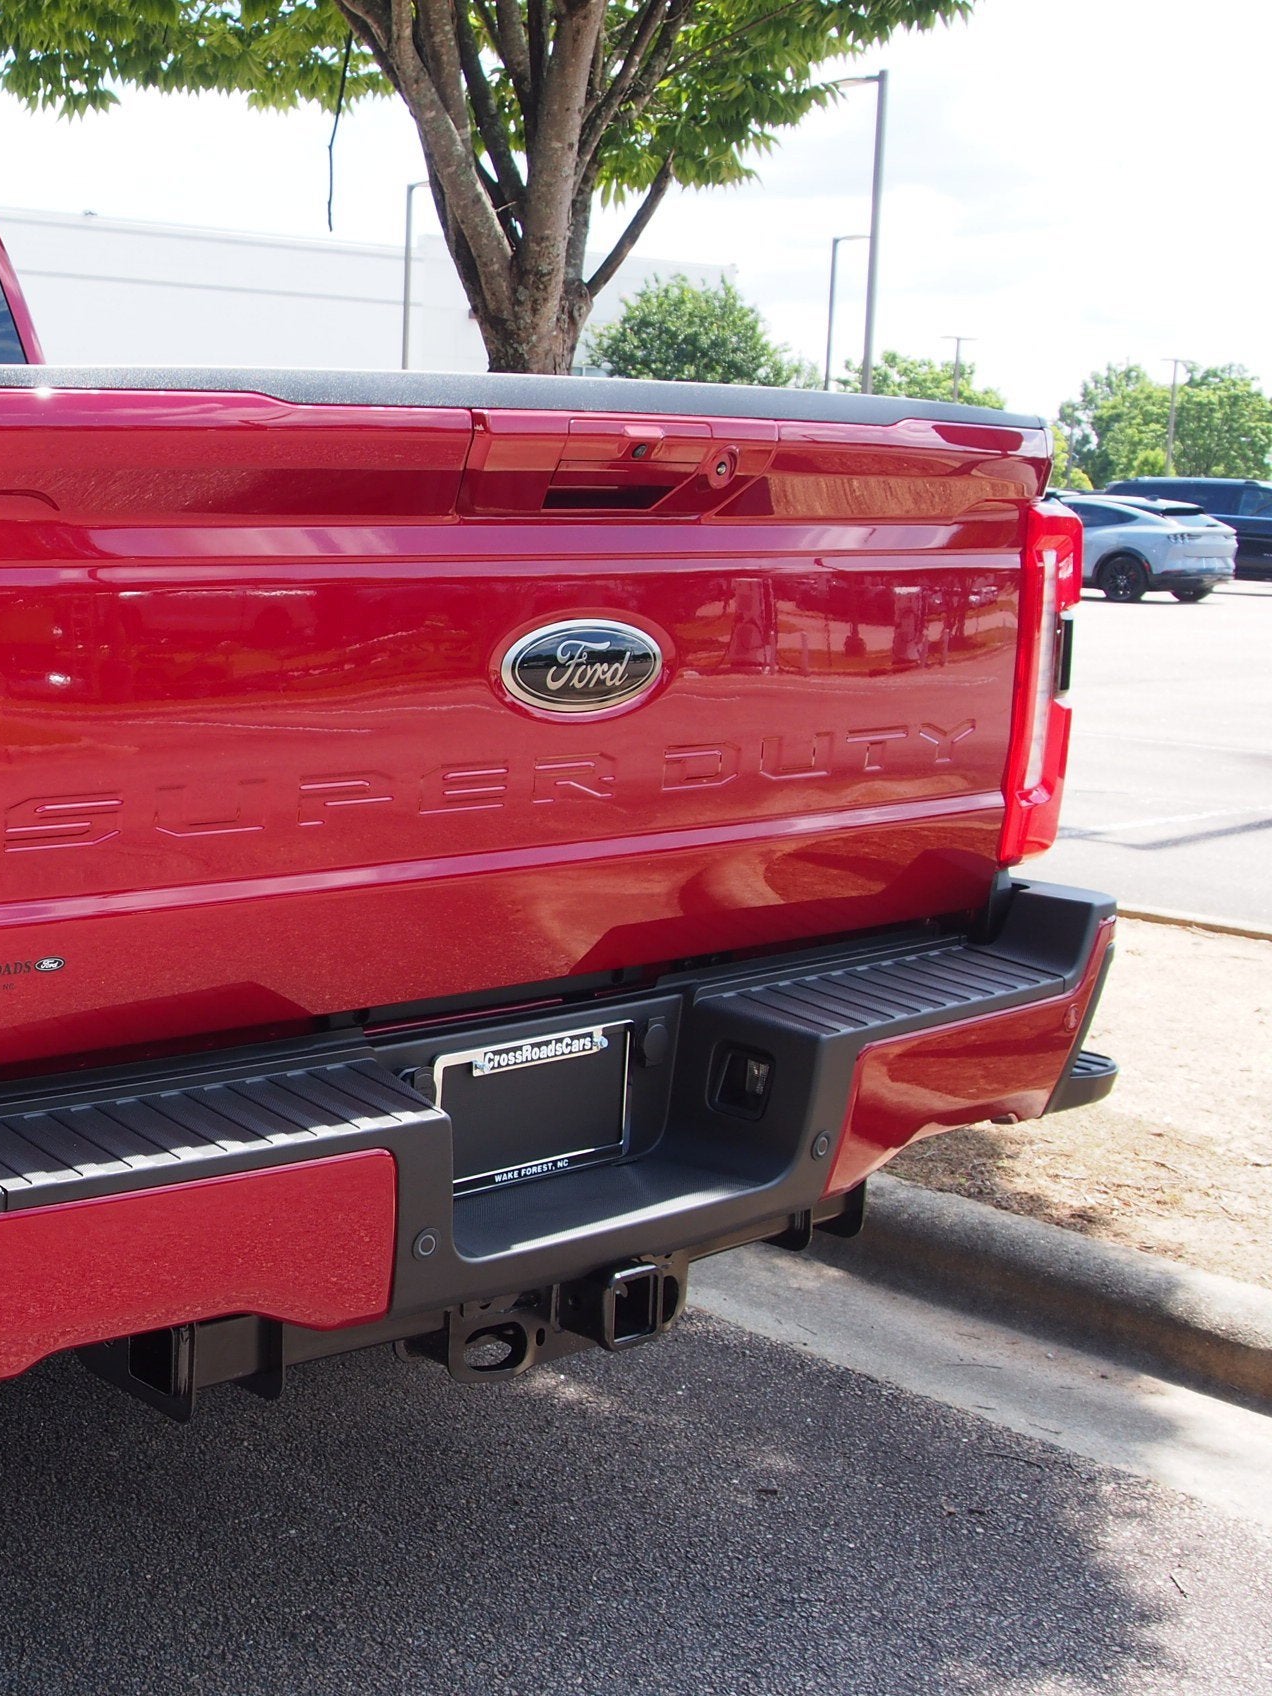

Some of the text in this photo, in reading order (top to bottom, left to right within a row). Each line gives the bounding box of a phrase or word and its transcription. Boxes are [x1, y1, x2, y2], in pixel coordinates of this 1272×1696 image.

[546, 640, 631, 691] Ford
[4, 717, 977, 853] SUPER DUTY
[485, 1037, 592, 1070] CrossRoadsCars
[494, 1159, 569, 1183] WAKE FOREST, NC
